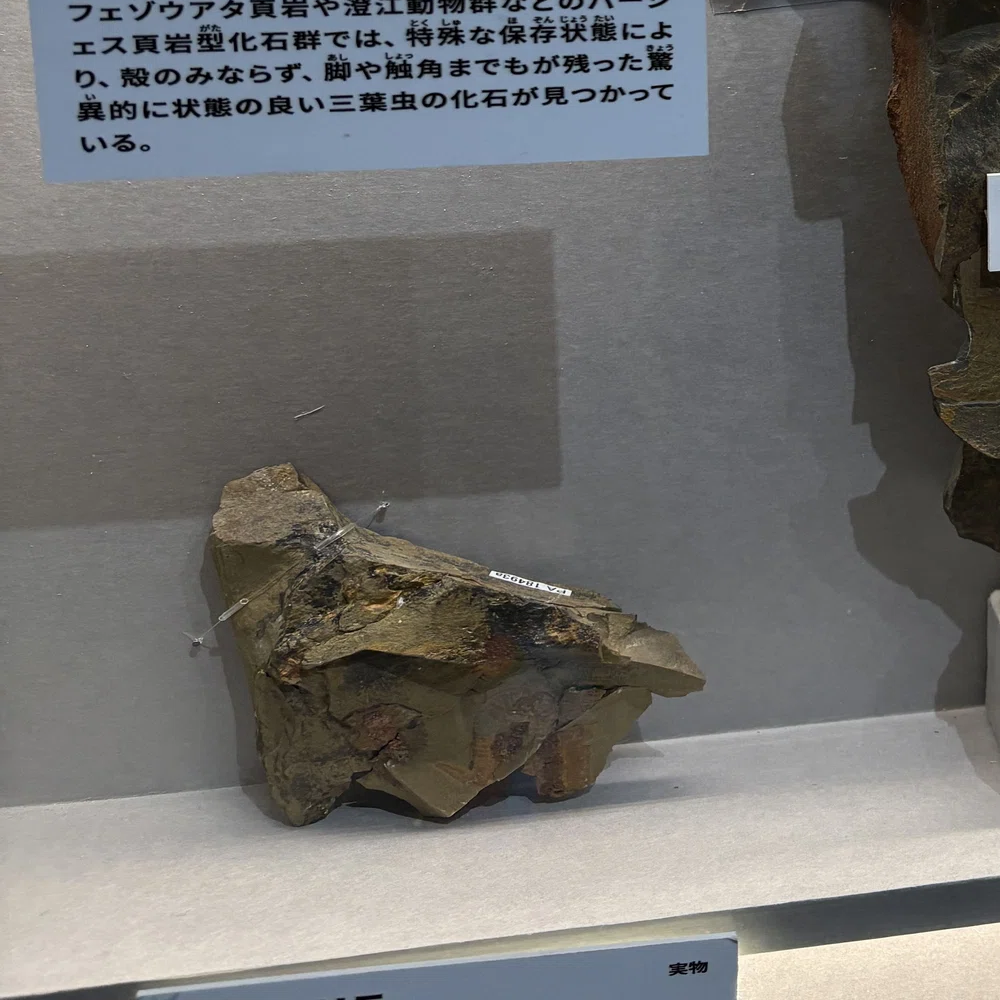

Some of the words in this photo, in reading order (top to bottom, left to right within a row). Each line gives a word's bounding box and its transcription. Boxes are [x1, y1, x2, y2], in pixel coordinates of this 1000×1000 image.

[72, 21, 673, 55] ェス頁岩型化石群では、特殊な保存状態によ
[74, 52, 674, 90] り、殻のみならず、脚や触角までもが残った驚
[78, 83, 675, 122] 異的に状態の良い三葉虫の化石が見つかって
[81, 133, 151, 154] いる。
[668, 960, 709, 977] 実物
